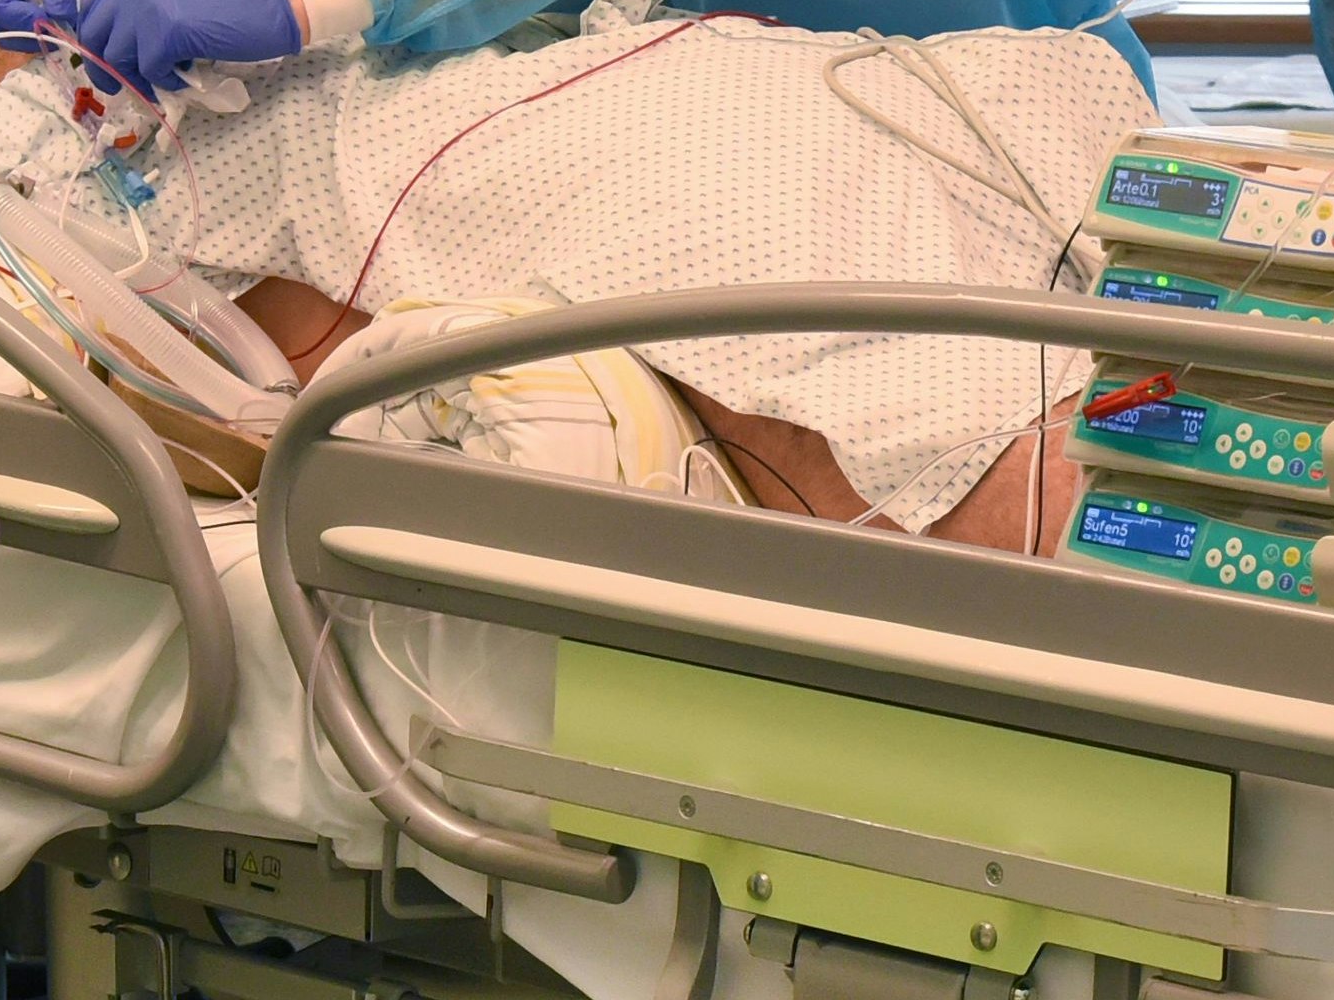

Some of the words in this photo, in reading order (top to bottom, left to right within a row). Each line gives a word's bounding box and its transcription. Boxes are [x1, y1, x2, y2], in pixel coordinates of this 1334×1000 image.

[1112, 180, 1159, 198] Arte0.1
[1210, 192, 1220, 206] 3
[1182, 419, 1199, 434] 10
[1083, 516, 1129, 537] Sufen5
[1174, 533, 1190, 548] 10
